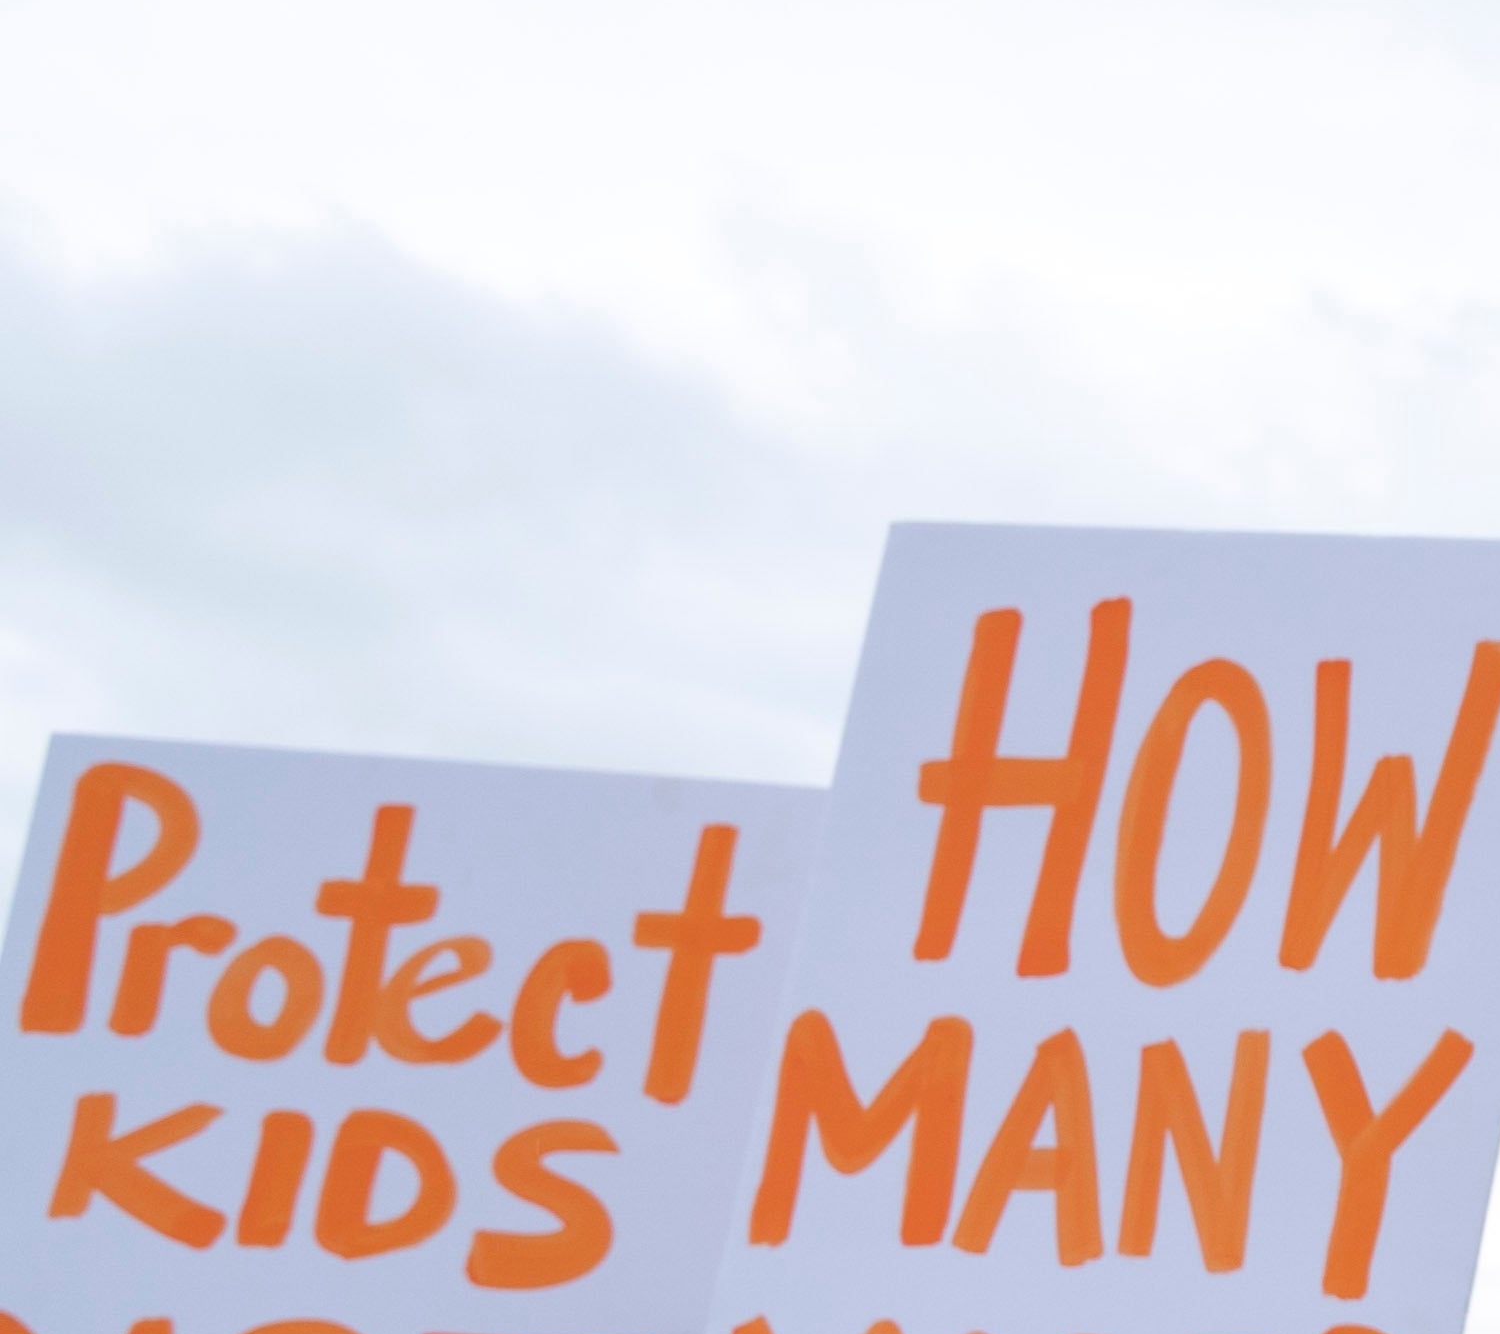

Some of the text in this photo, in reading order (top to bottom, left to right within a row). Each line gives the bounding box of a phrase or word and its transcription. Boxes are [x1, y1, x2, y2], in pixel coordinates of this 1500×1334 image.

[19, 760, 762, 1105] Protect
[48, 1092, 620, 1290] KIDS
[749, 1009, 1475, 1301] MANY
